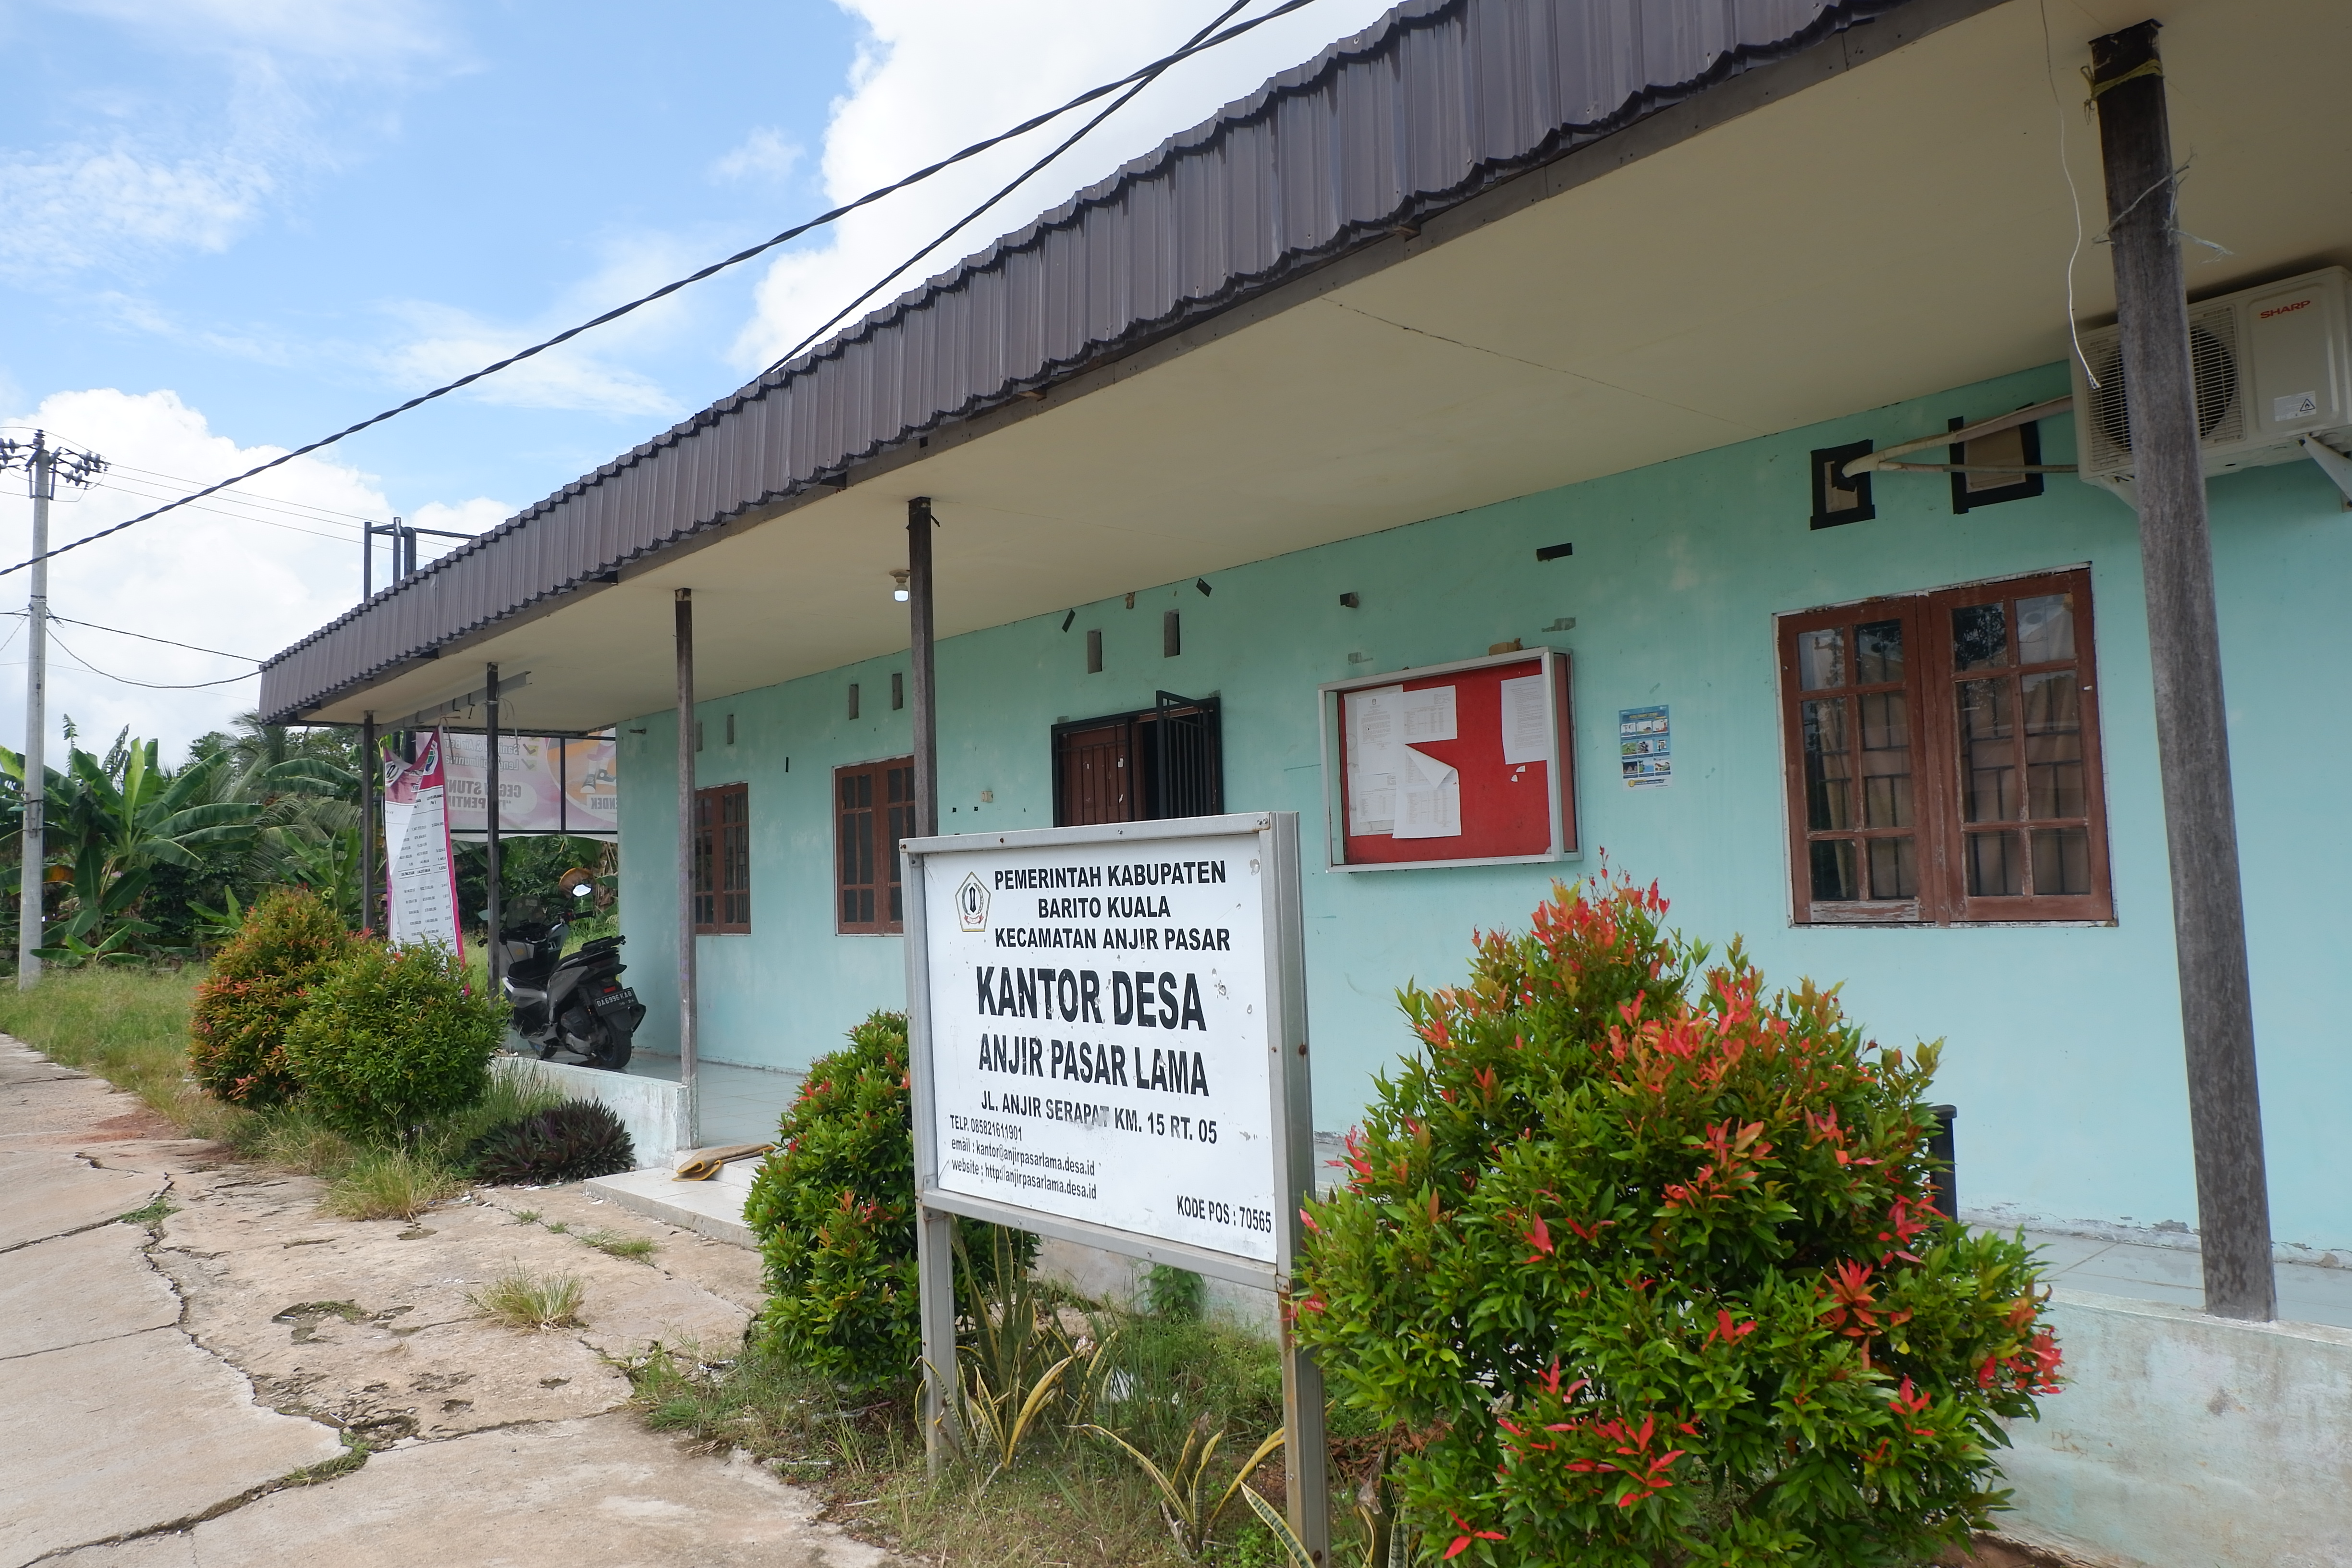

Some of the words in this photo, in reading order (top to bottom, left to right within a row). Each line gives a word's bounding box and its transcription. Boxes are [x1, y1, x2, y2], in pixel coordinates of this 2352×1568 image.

[2260, 300, 2311, 319] SHARP
[995, 866, 1101, 890] PEMERINTAH
[1108, 860, 1226, 887] KABUPATEN
[1039, 897, 1101, 919] BARITO
[1108, 895, 1171, 918] KUALA
[995, 927, 1096, 949] KECAMATAN
[1103, 928, 1158, 950] ANJIR
[1165, 928, 1230, 951] PASAR
[977, 966, 1103, 1024] KANTOR
[1113, 970, 1207, 1031] DESA
[979, 1033, 1043, 1078] ANJIR
[1051, 1040, 1127, 1087] PASAR
[1135, 1046, 1209, 1097] LAMA
[950, 1115, 969, 1131] TELP.
[971, 1118, 1022, 1141] 085821611901
[981, 1090, 998, 1111] JL.
[1003, 1093, 1041, 1118] ANJIR
[1046, 1099, 1109, 1127] SERAPAT
[1115, 1107, 1141, 1132] KM.
[1148, 1112, 1164, 1136] 15
[1171, 1115, 1192, 1140] RT.
[1199, 1119, 1217, 1144] 05
[952, 1138, 970, 1152] email
[976, 1139, 1094, 1176] kantor@anjirpasarlama.desa.id
[952, 1158, 979, 1175] website
[1177, 1195, 1205, 1219] KODE
[1209, 1200, 1229, 1224] POS
[1239, 1206, 1271, 1233] 70565
